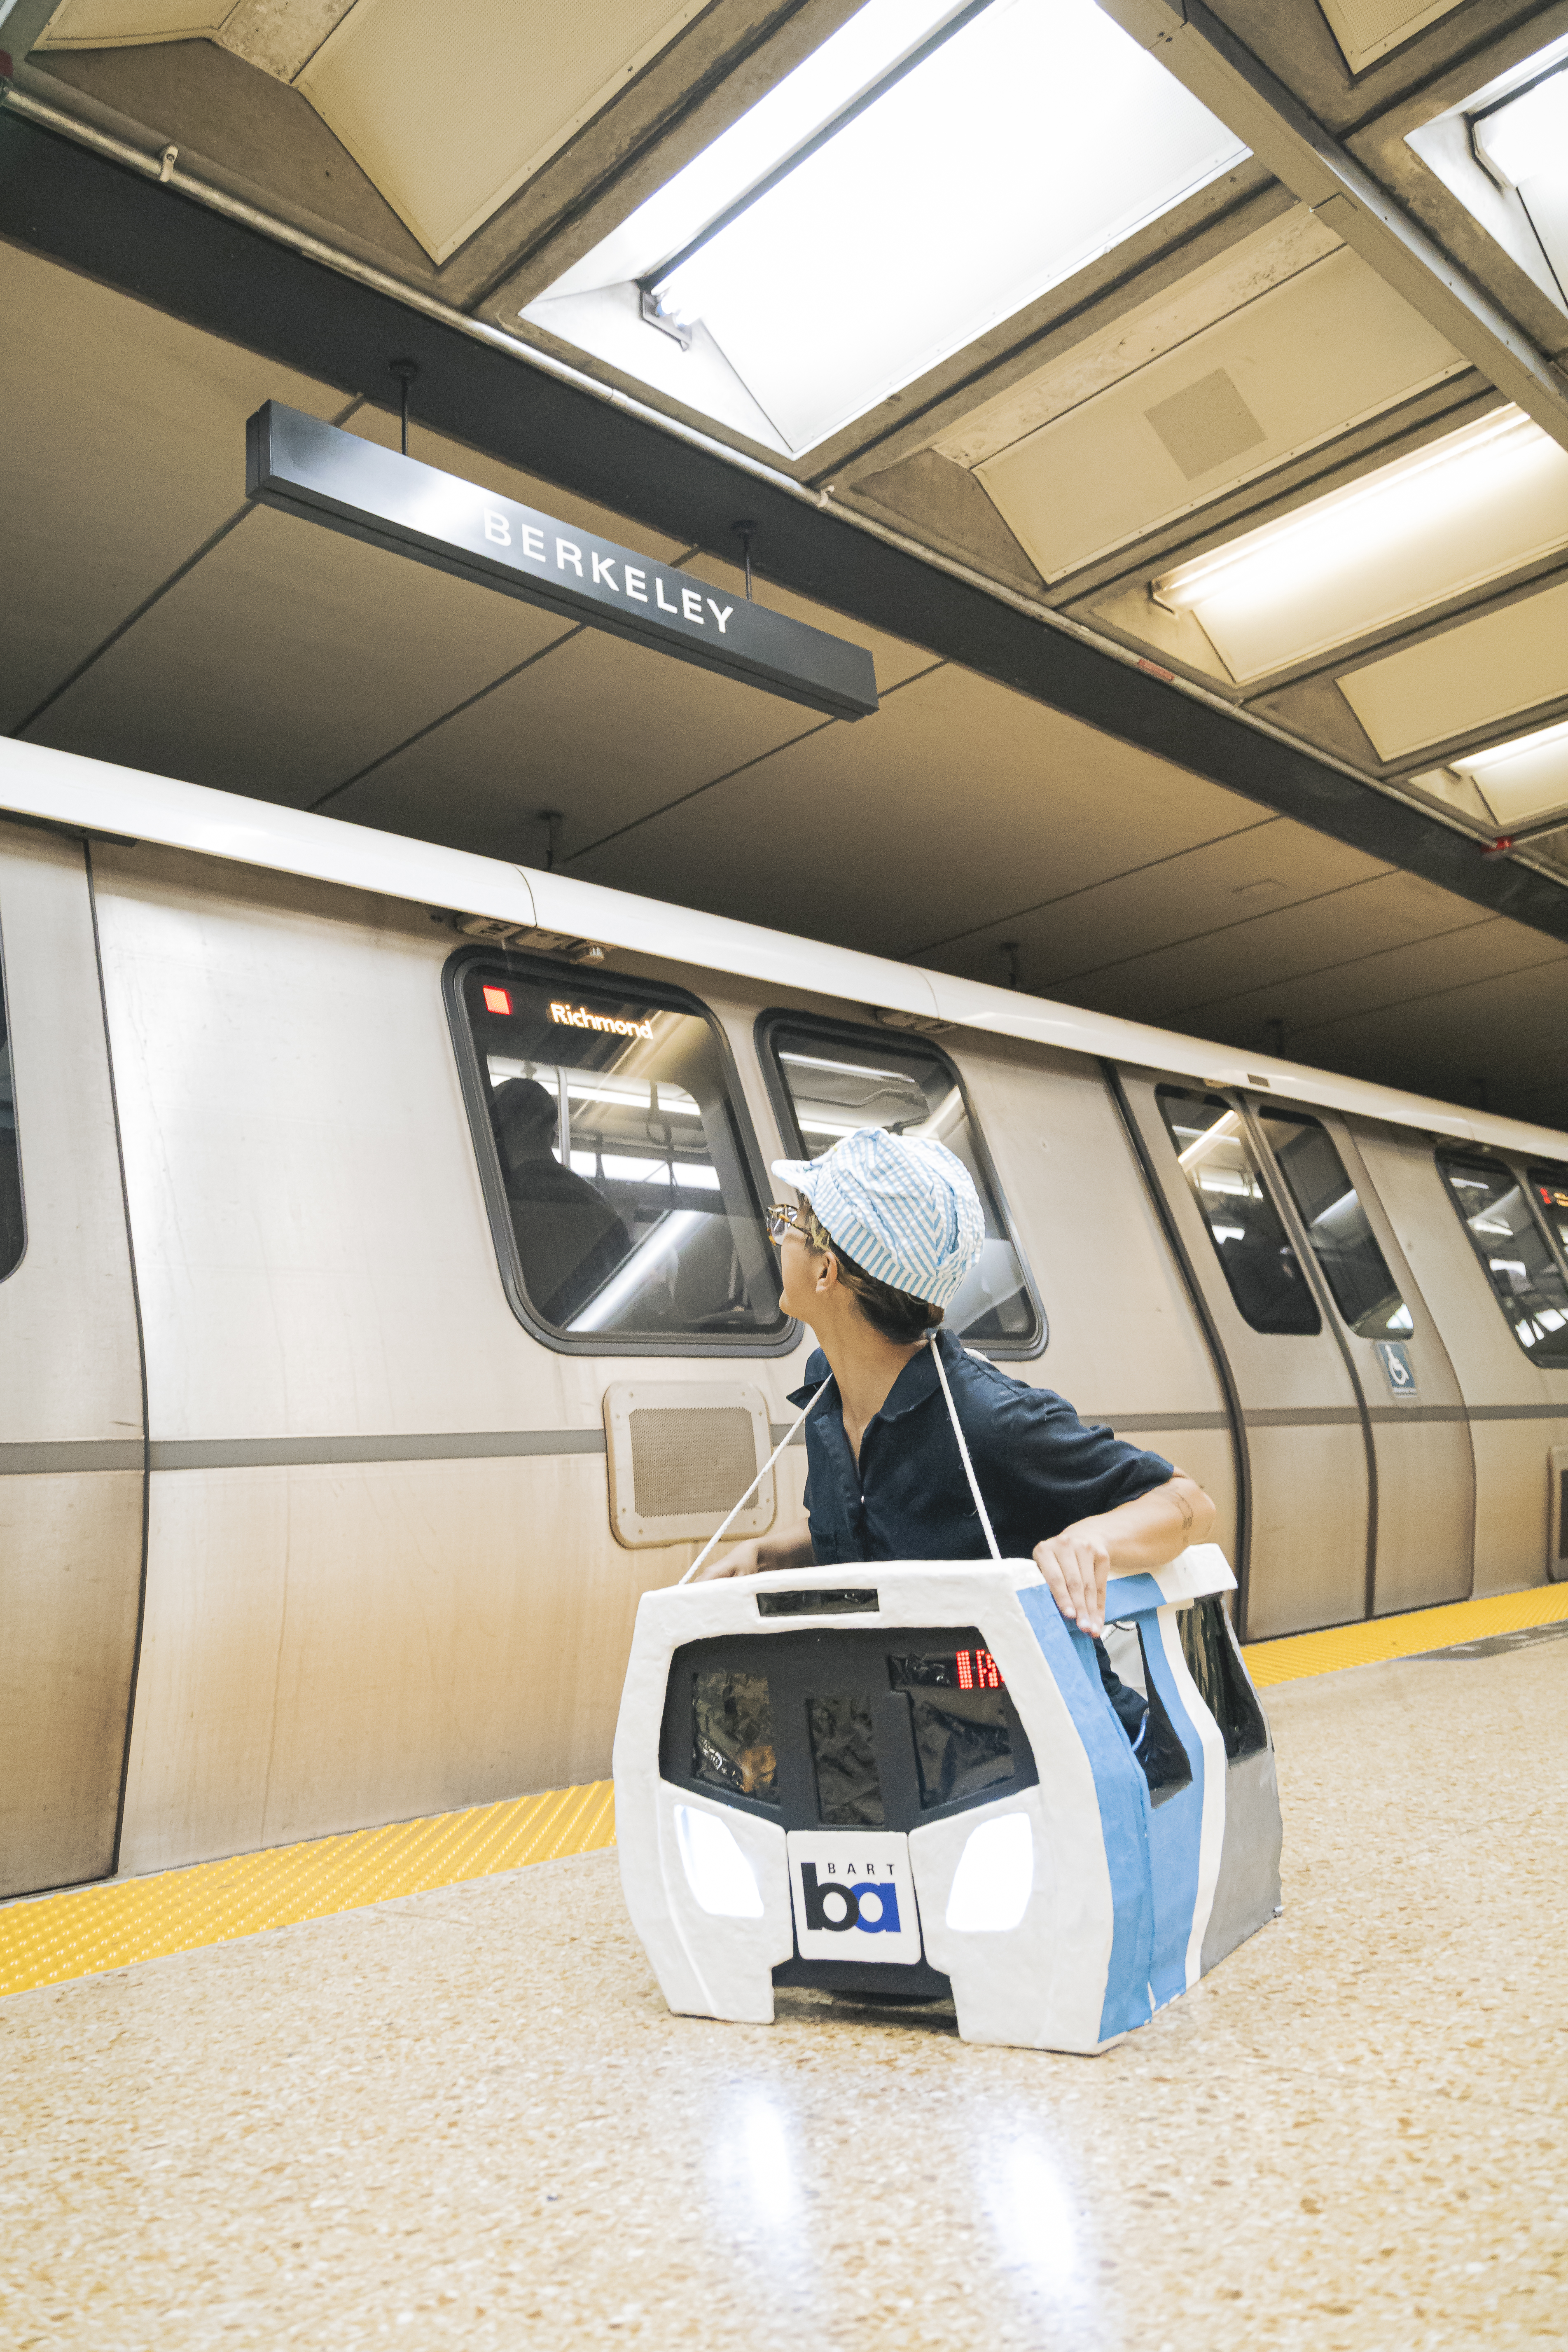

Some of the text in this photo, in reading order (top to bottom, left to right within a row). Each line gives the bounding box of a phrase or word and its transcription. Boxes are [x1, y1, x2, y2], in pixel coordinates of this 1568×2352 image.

[483, 507, 733, 633] BERKELEY
[550, 1003, 654, 1039] Richmond
[828, 1863, 894, 1875] BART
[801, 1862, 901, 1933] ba
